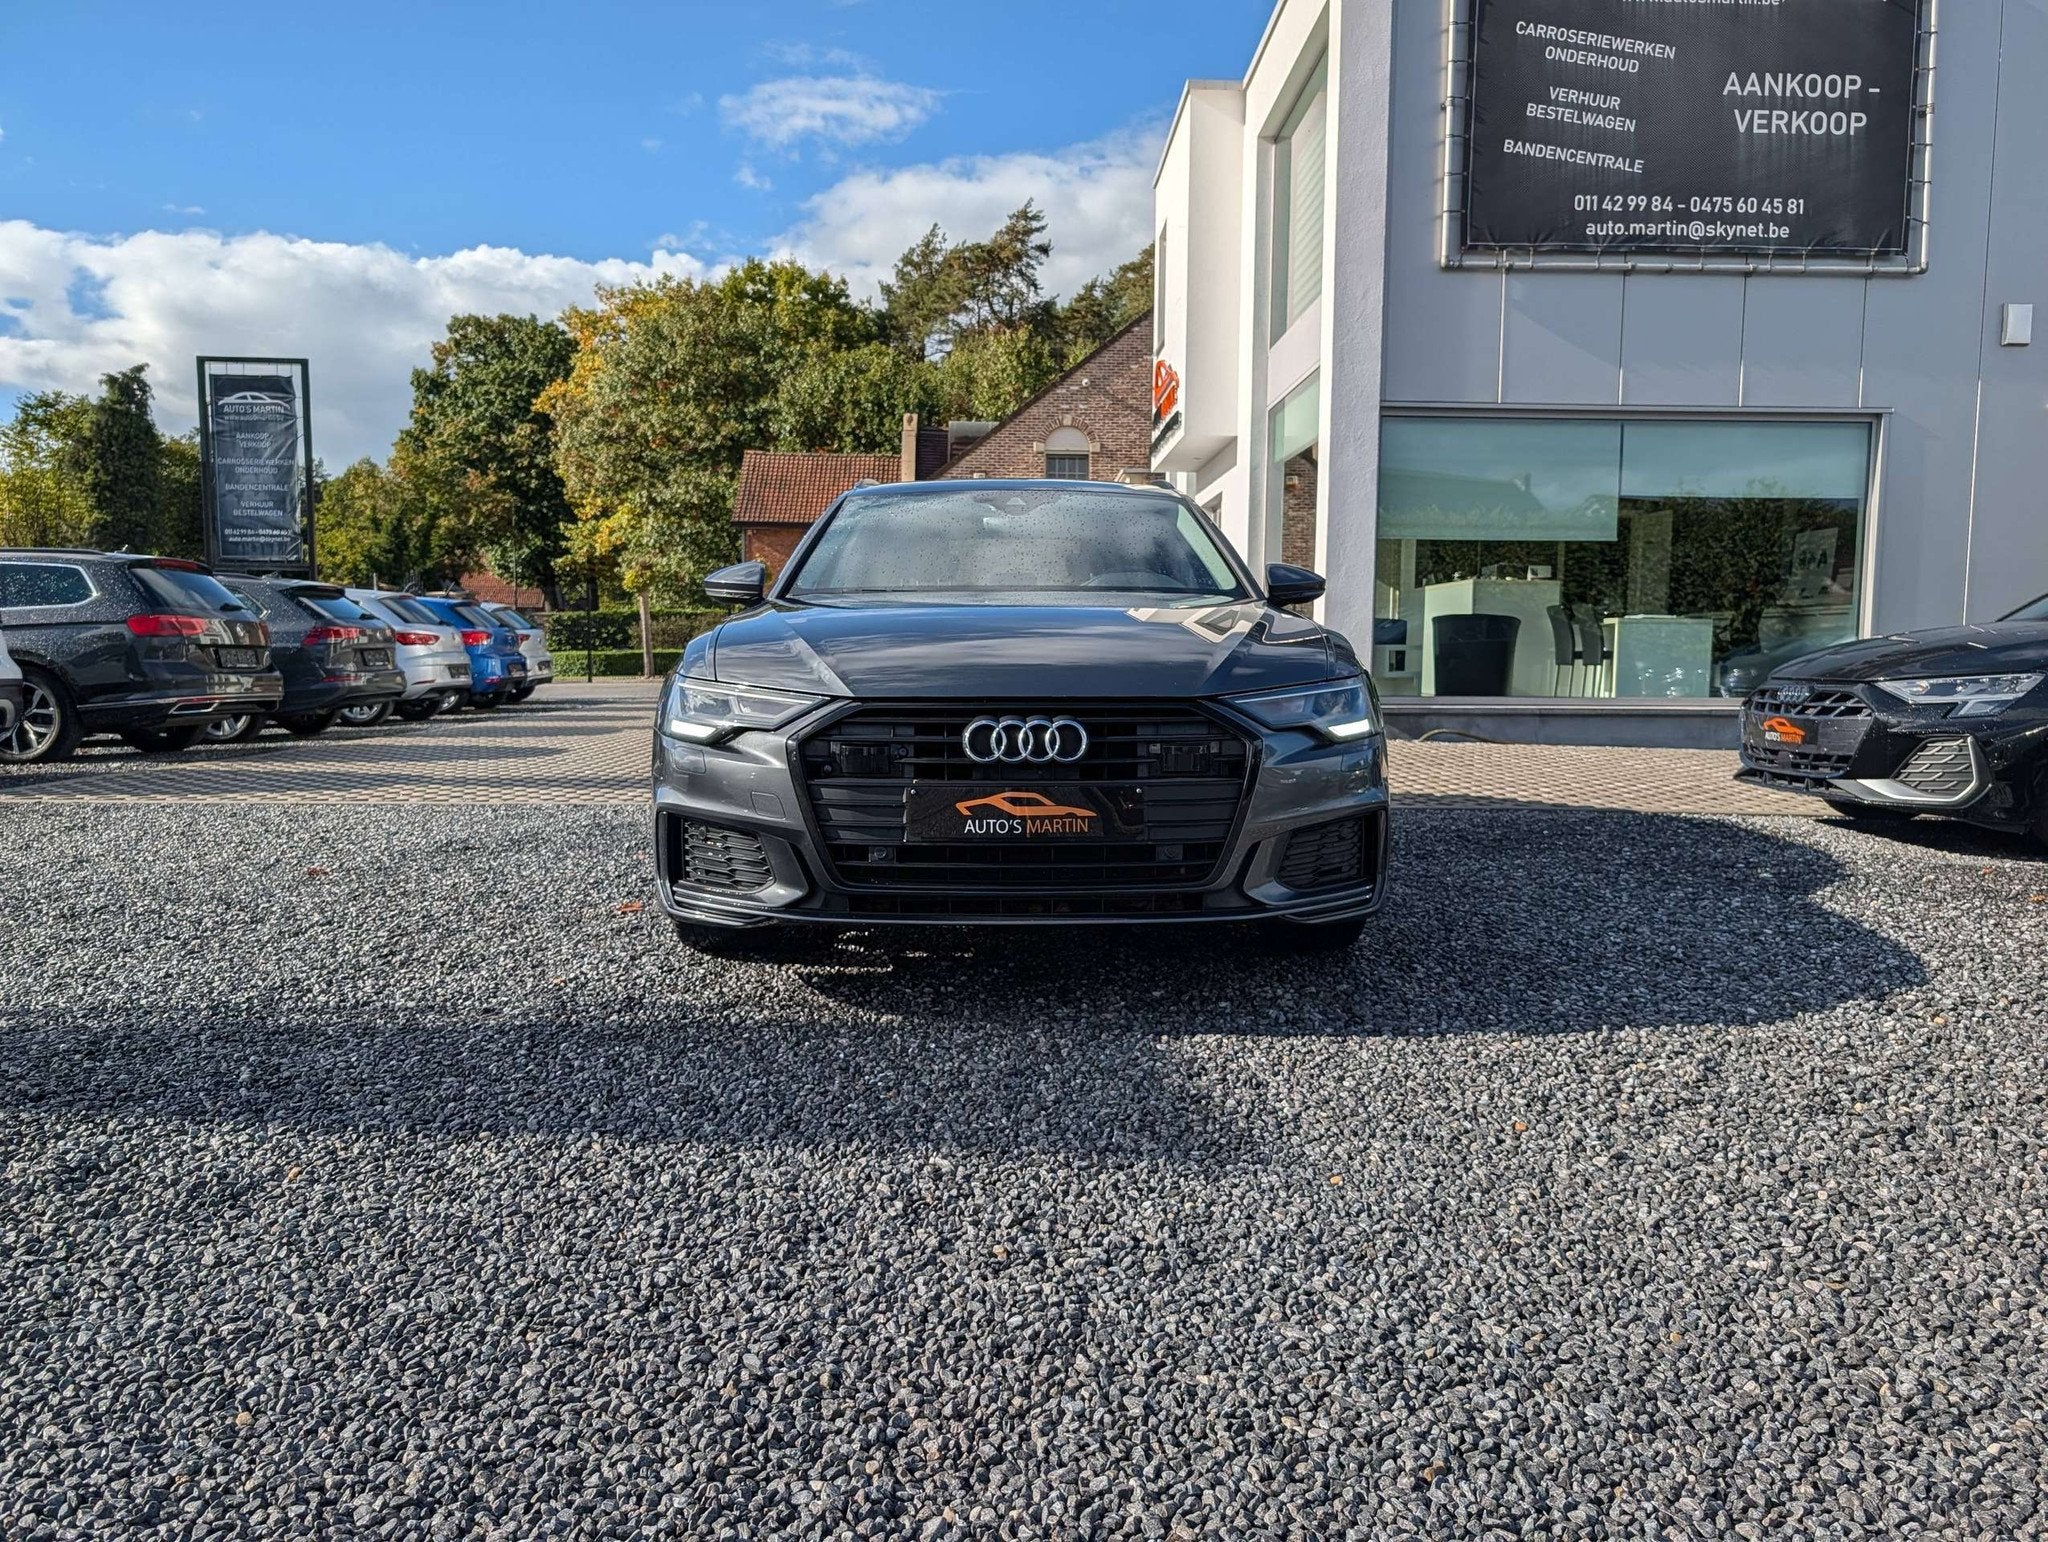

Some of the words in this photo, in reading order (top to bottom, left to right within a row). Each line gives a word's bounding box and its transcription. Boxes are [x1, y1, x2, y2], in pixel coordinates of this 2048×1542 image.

[1515, 21, 1676, 60] CARROSERIEWERKEN
[1545, 46, 1640, 73] ONDERHOUD
[1722, 71, 1862, 99] AANKOOP
[1549, 86, 1621, 110] VERHUUR
[1526, 103, 1636, 132] BESTELWAGEN
[1733, 108, 1868, 136] VERKOOP
[1503, 139, 1645, 173] BANDENCENTRALE
[1574, 194, 1598, 211] 011
[1602, 195, 1623, 212] 42
[1627, 195, 1648, 212] 99
[1651, 195, 1673, 212] 84
[1690, 196, 1733, 213] 0475
[1736, 197, 1758, 213] 60
[1761, 198, 1783, 214] 45
[1787, 198, 1804, 215] 81
[1585, 220, 1790, 240] auto.martin@skynet.be
[252, 405, 285, 414] MARTIN
[240, 500, 274, 508] VERHUUR
[964, 818, 1022, 834] AUTO'S
[1026, 818, 1089, 833] MARTIN
